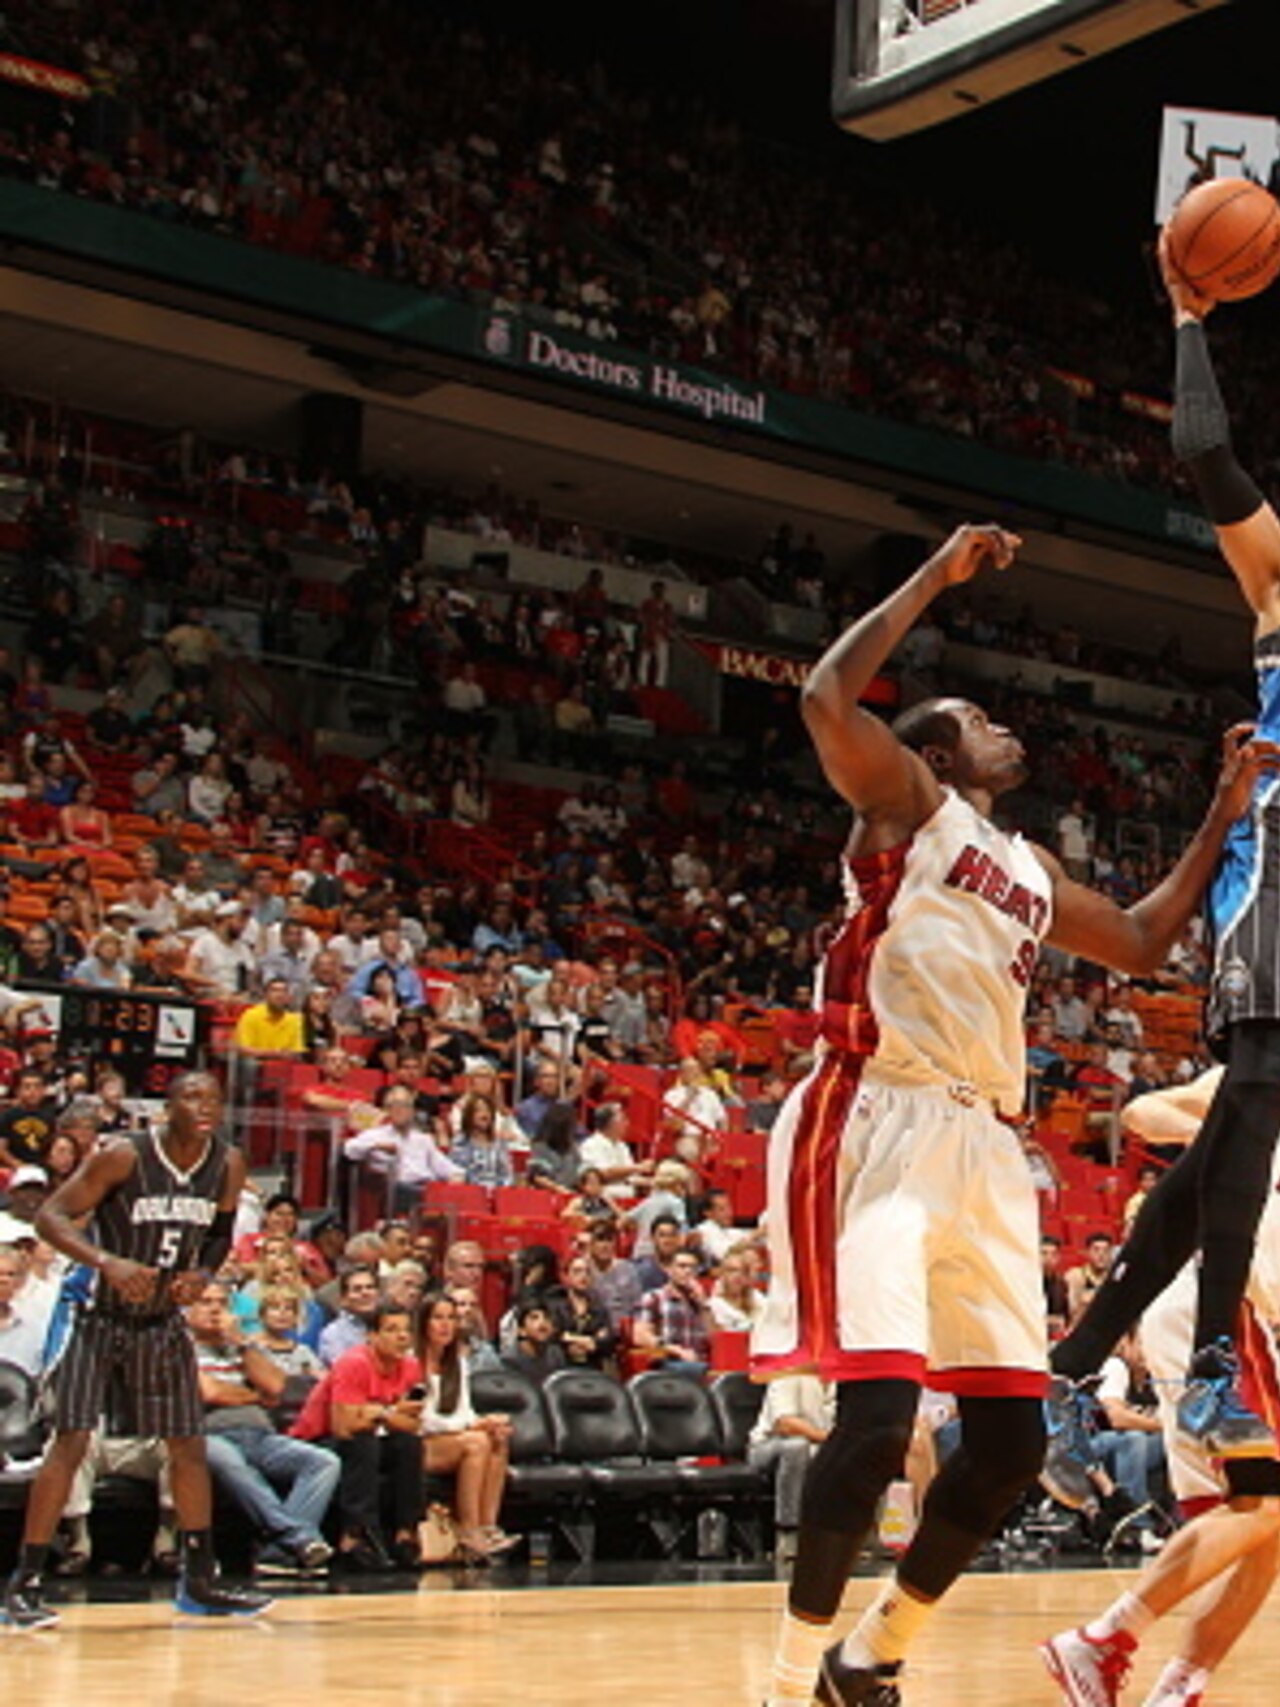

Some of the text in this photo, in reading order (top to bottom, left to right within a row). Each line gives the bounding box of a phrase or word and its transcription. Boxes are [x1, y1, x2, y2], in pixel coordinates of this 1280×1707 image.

[528, 331, 765, 423] Doctors Hospital
[943, 844, 1048, 936] HEAT
[158, 1231, 182, 1268] 5
